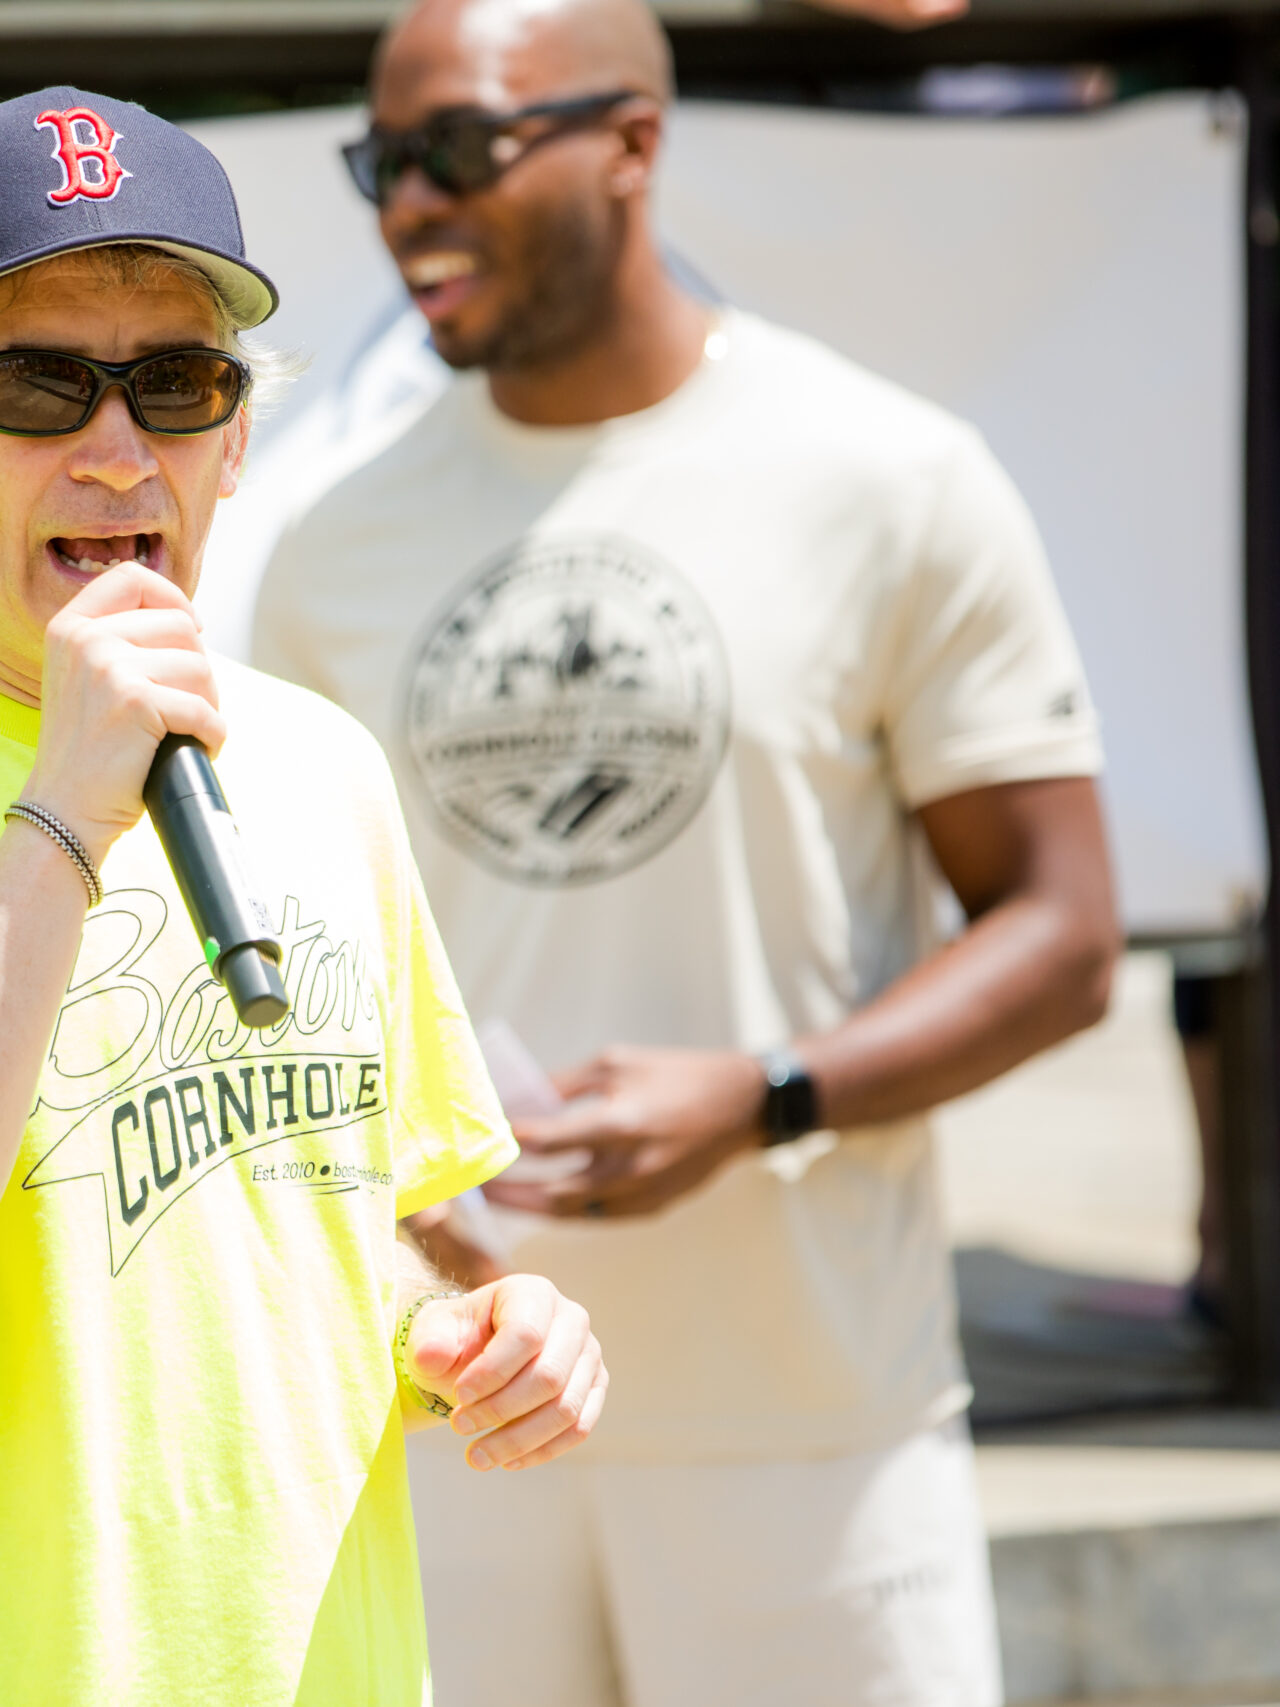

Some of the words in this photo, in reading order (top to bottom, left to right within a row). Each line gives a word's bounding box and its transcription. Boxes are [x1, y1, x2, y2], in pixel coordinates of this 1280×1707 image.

[33, 106, 134, 207] B
[110, 1062, 382, 1226] CORNHOLE
[252, 1164, 278, 1181] Est.
[282, 1161, 316, 1180] 2010
